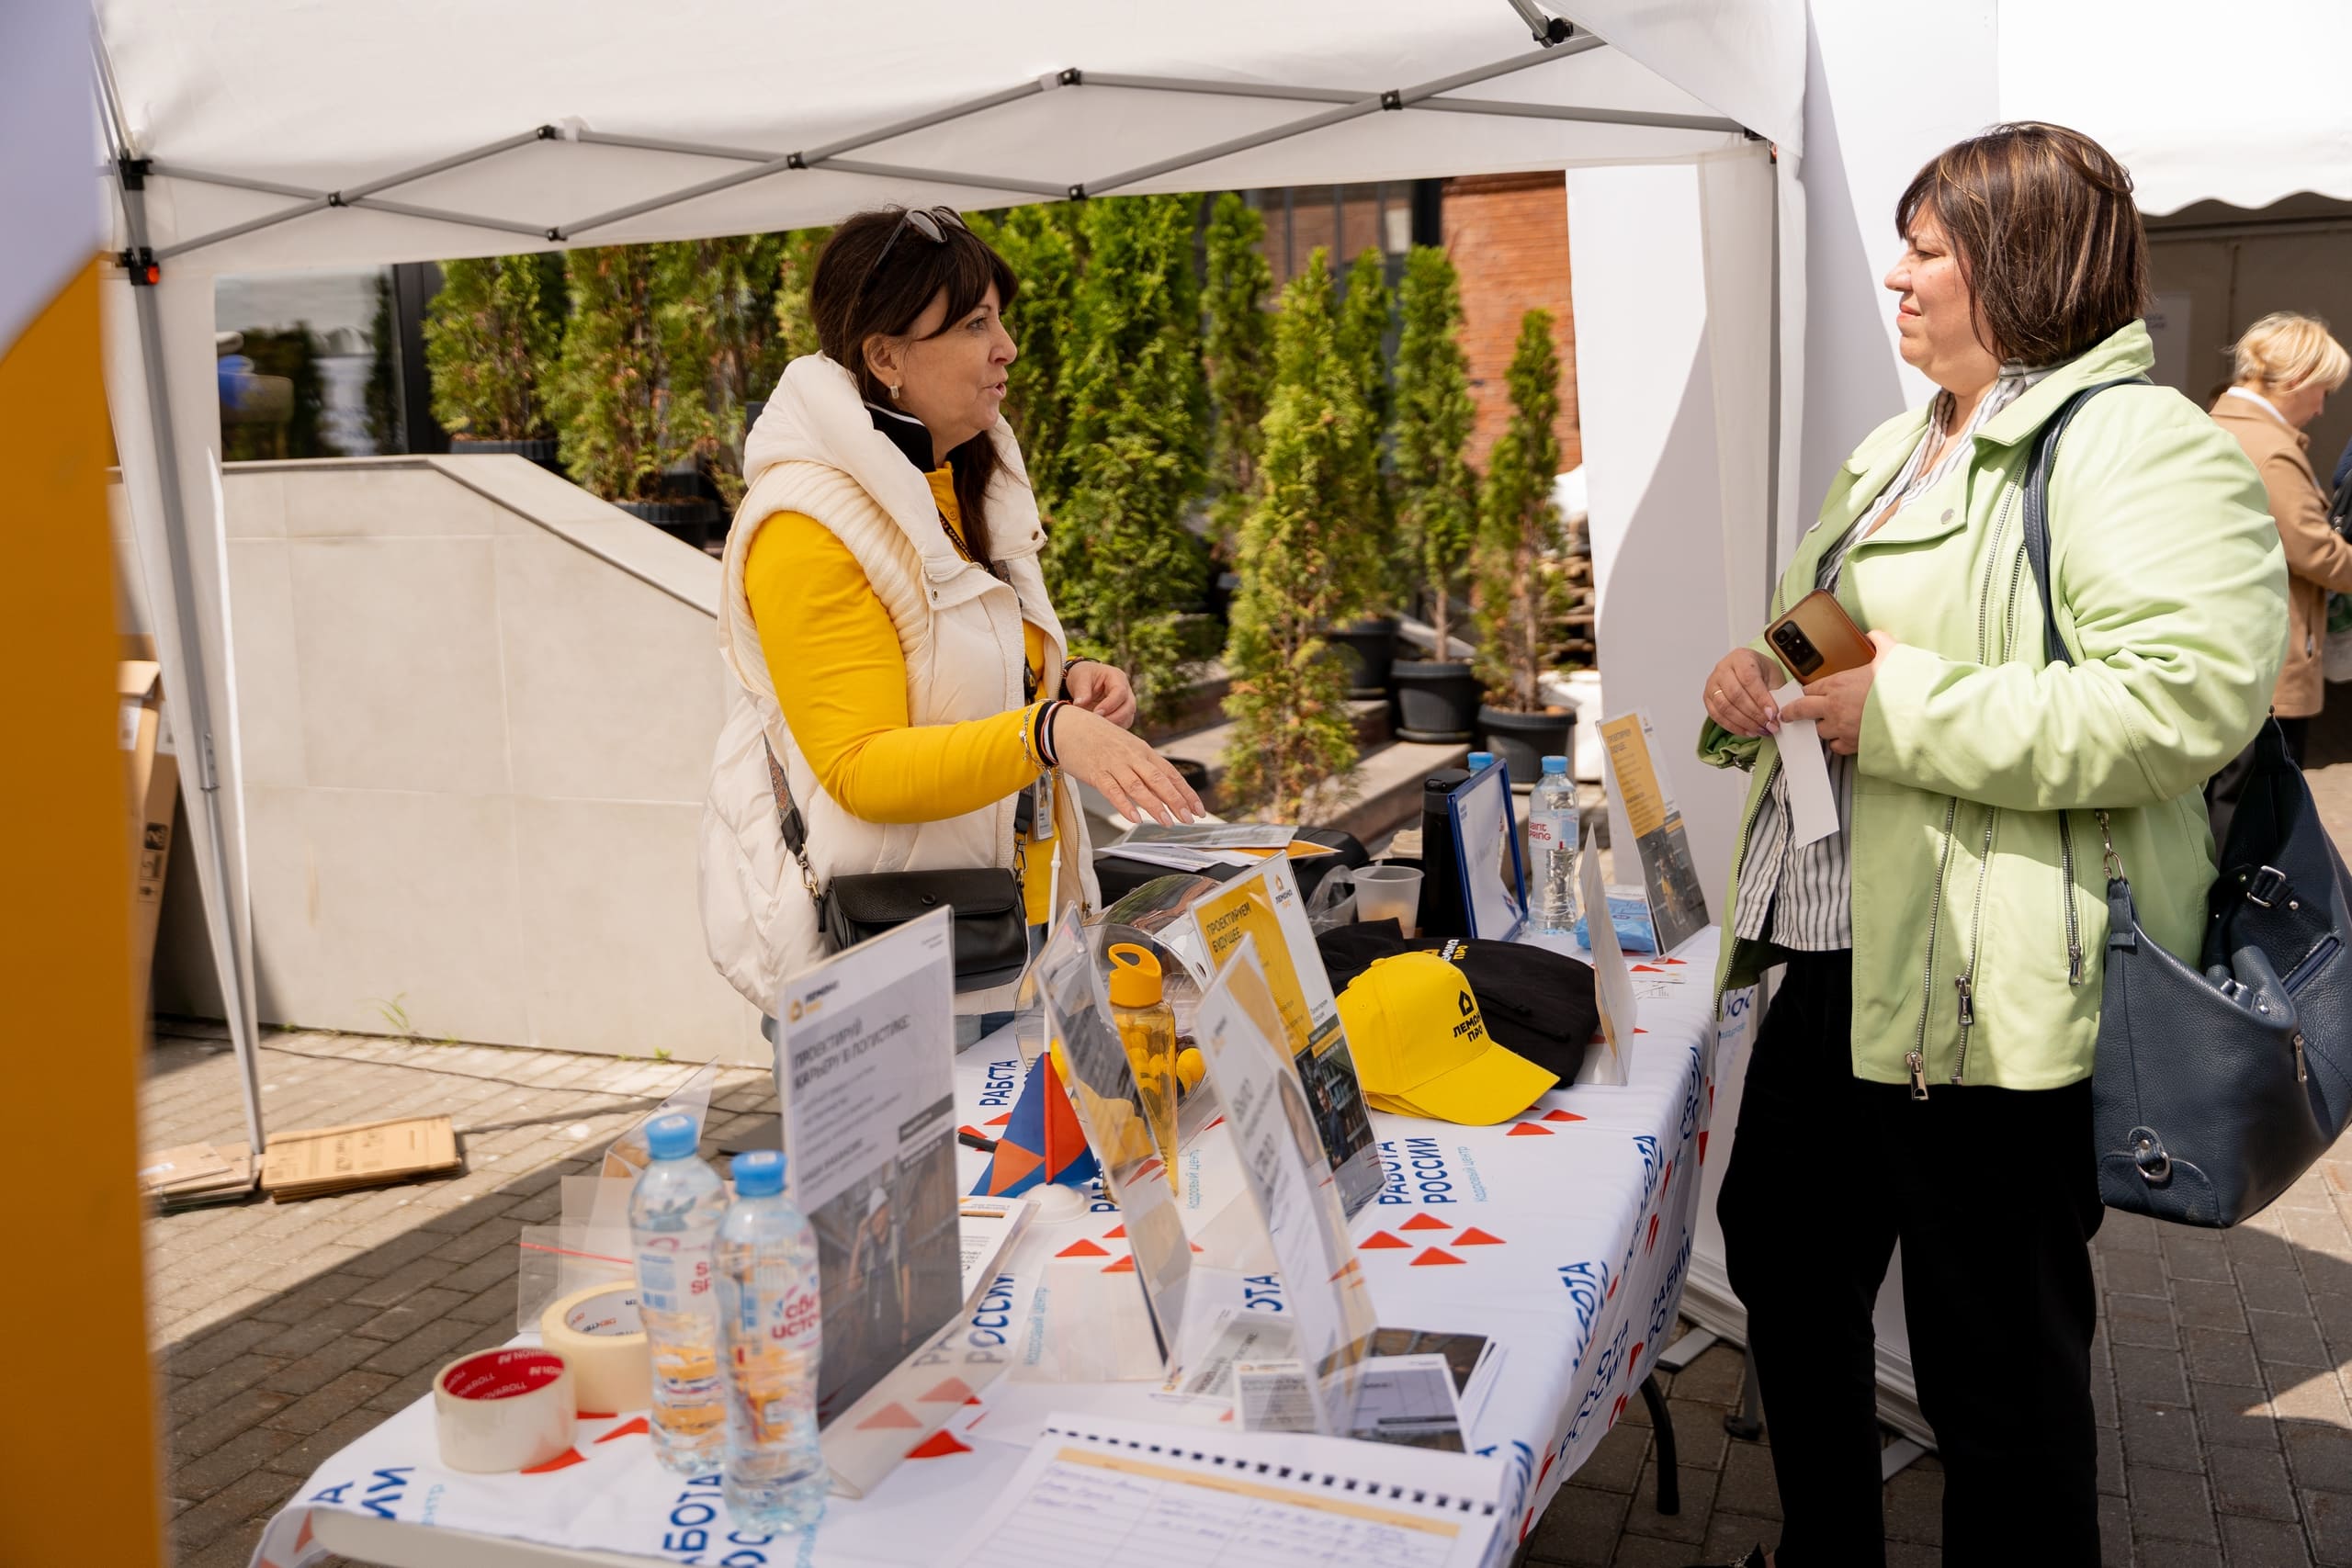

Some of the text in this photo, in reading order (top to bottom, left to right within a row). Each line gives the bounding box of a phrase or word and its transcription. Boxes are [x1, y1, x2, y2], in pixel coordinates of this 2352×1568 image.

[1205, 901, 1251, 938] ПРОЕКТИРУЕМ
[1212, 926, 1241, 953] БУДУЩЕЕ
[1467, 1024, 1483, 1043] ПРО
[1378, 1141, 1412, 1205] РАБОТА
[1405, 1138, 1457, 1203] РОССИИ
[1243, 1273, 1283, 1313] ОТА
